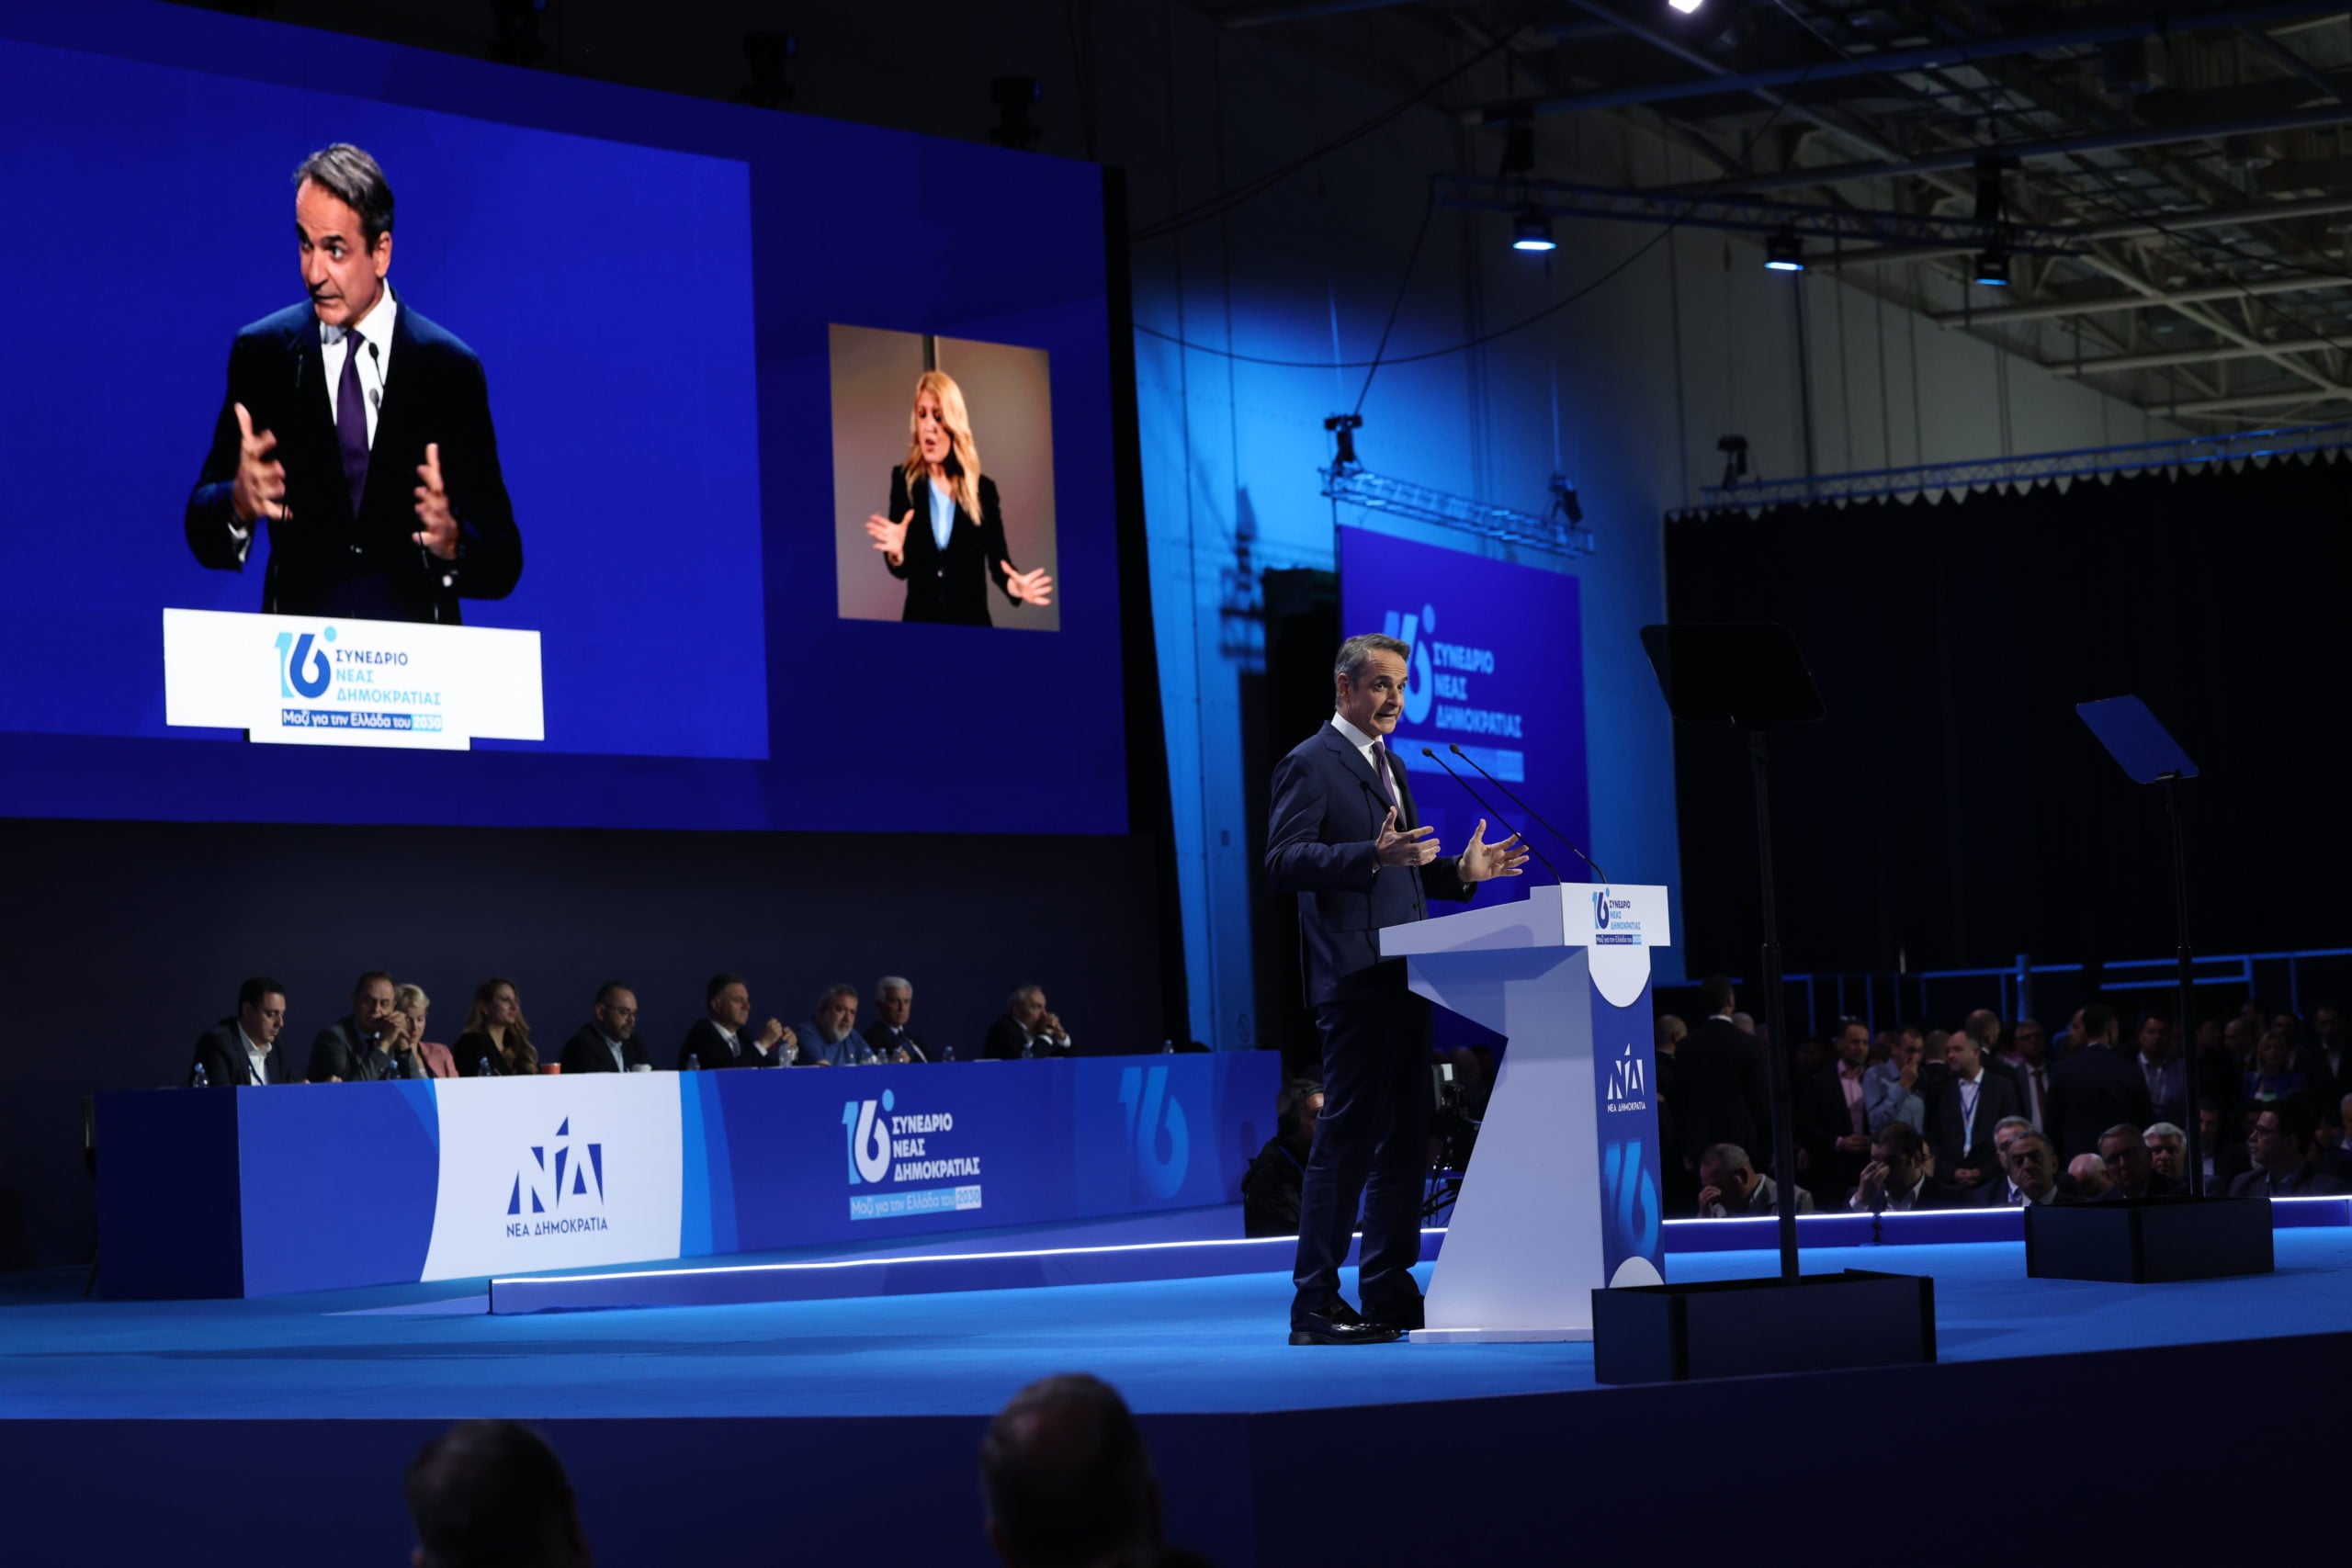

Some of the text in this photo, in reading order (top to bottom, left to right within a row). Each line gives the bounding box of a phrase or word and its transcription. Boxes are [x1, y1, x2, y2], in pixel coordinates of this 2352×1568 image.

[336, 649, 408, 665] ΣΥΝΕΔΡΙΟ
[336, 669, 374, 682] ΝΕΑΣ
[336, 687, 441, 705] ΔΗΜΟΚΡΑΤΙΑΣ
[311, 714, 328, 727] για
[330, 715, 349, 727] την
[350, 712, 390, 728] Ελλάδα
[393, 717, 411, 729] του
[1608, 1101, 1645, 1112] ΝΕΑ ΔΗΜΟΚΡΑΤΙΑ
[891, 1112, 953, 1134] ΣΥΝΕΔΡΙΟ
[1118, 1066, 1189, 1201] 16
[893, 1138, 925, 1158] ΝΕΑΣ
[894, 1156, 980, 1182] ΔΗΜΟΚΡΑΤΙΑΣ
[957, 1190, 980, 1204] 2030
[506, 1217, 608, 1238] ΝΕΑ ΔΗΜΟΚΡΑΤΙΑ
